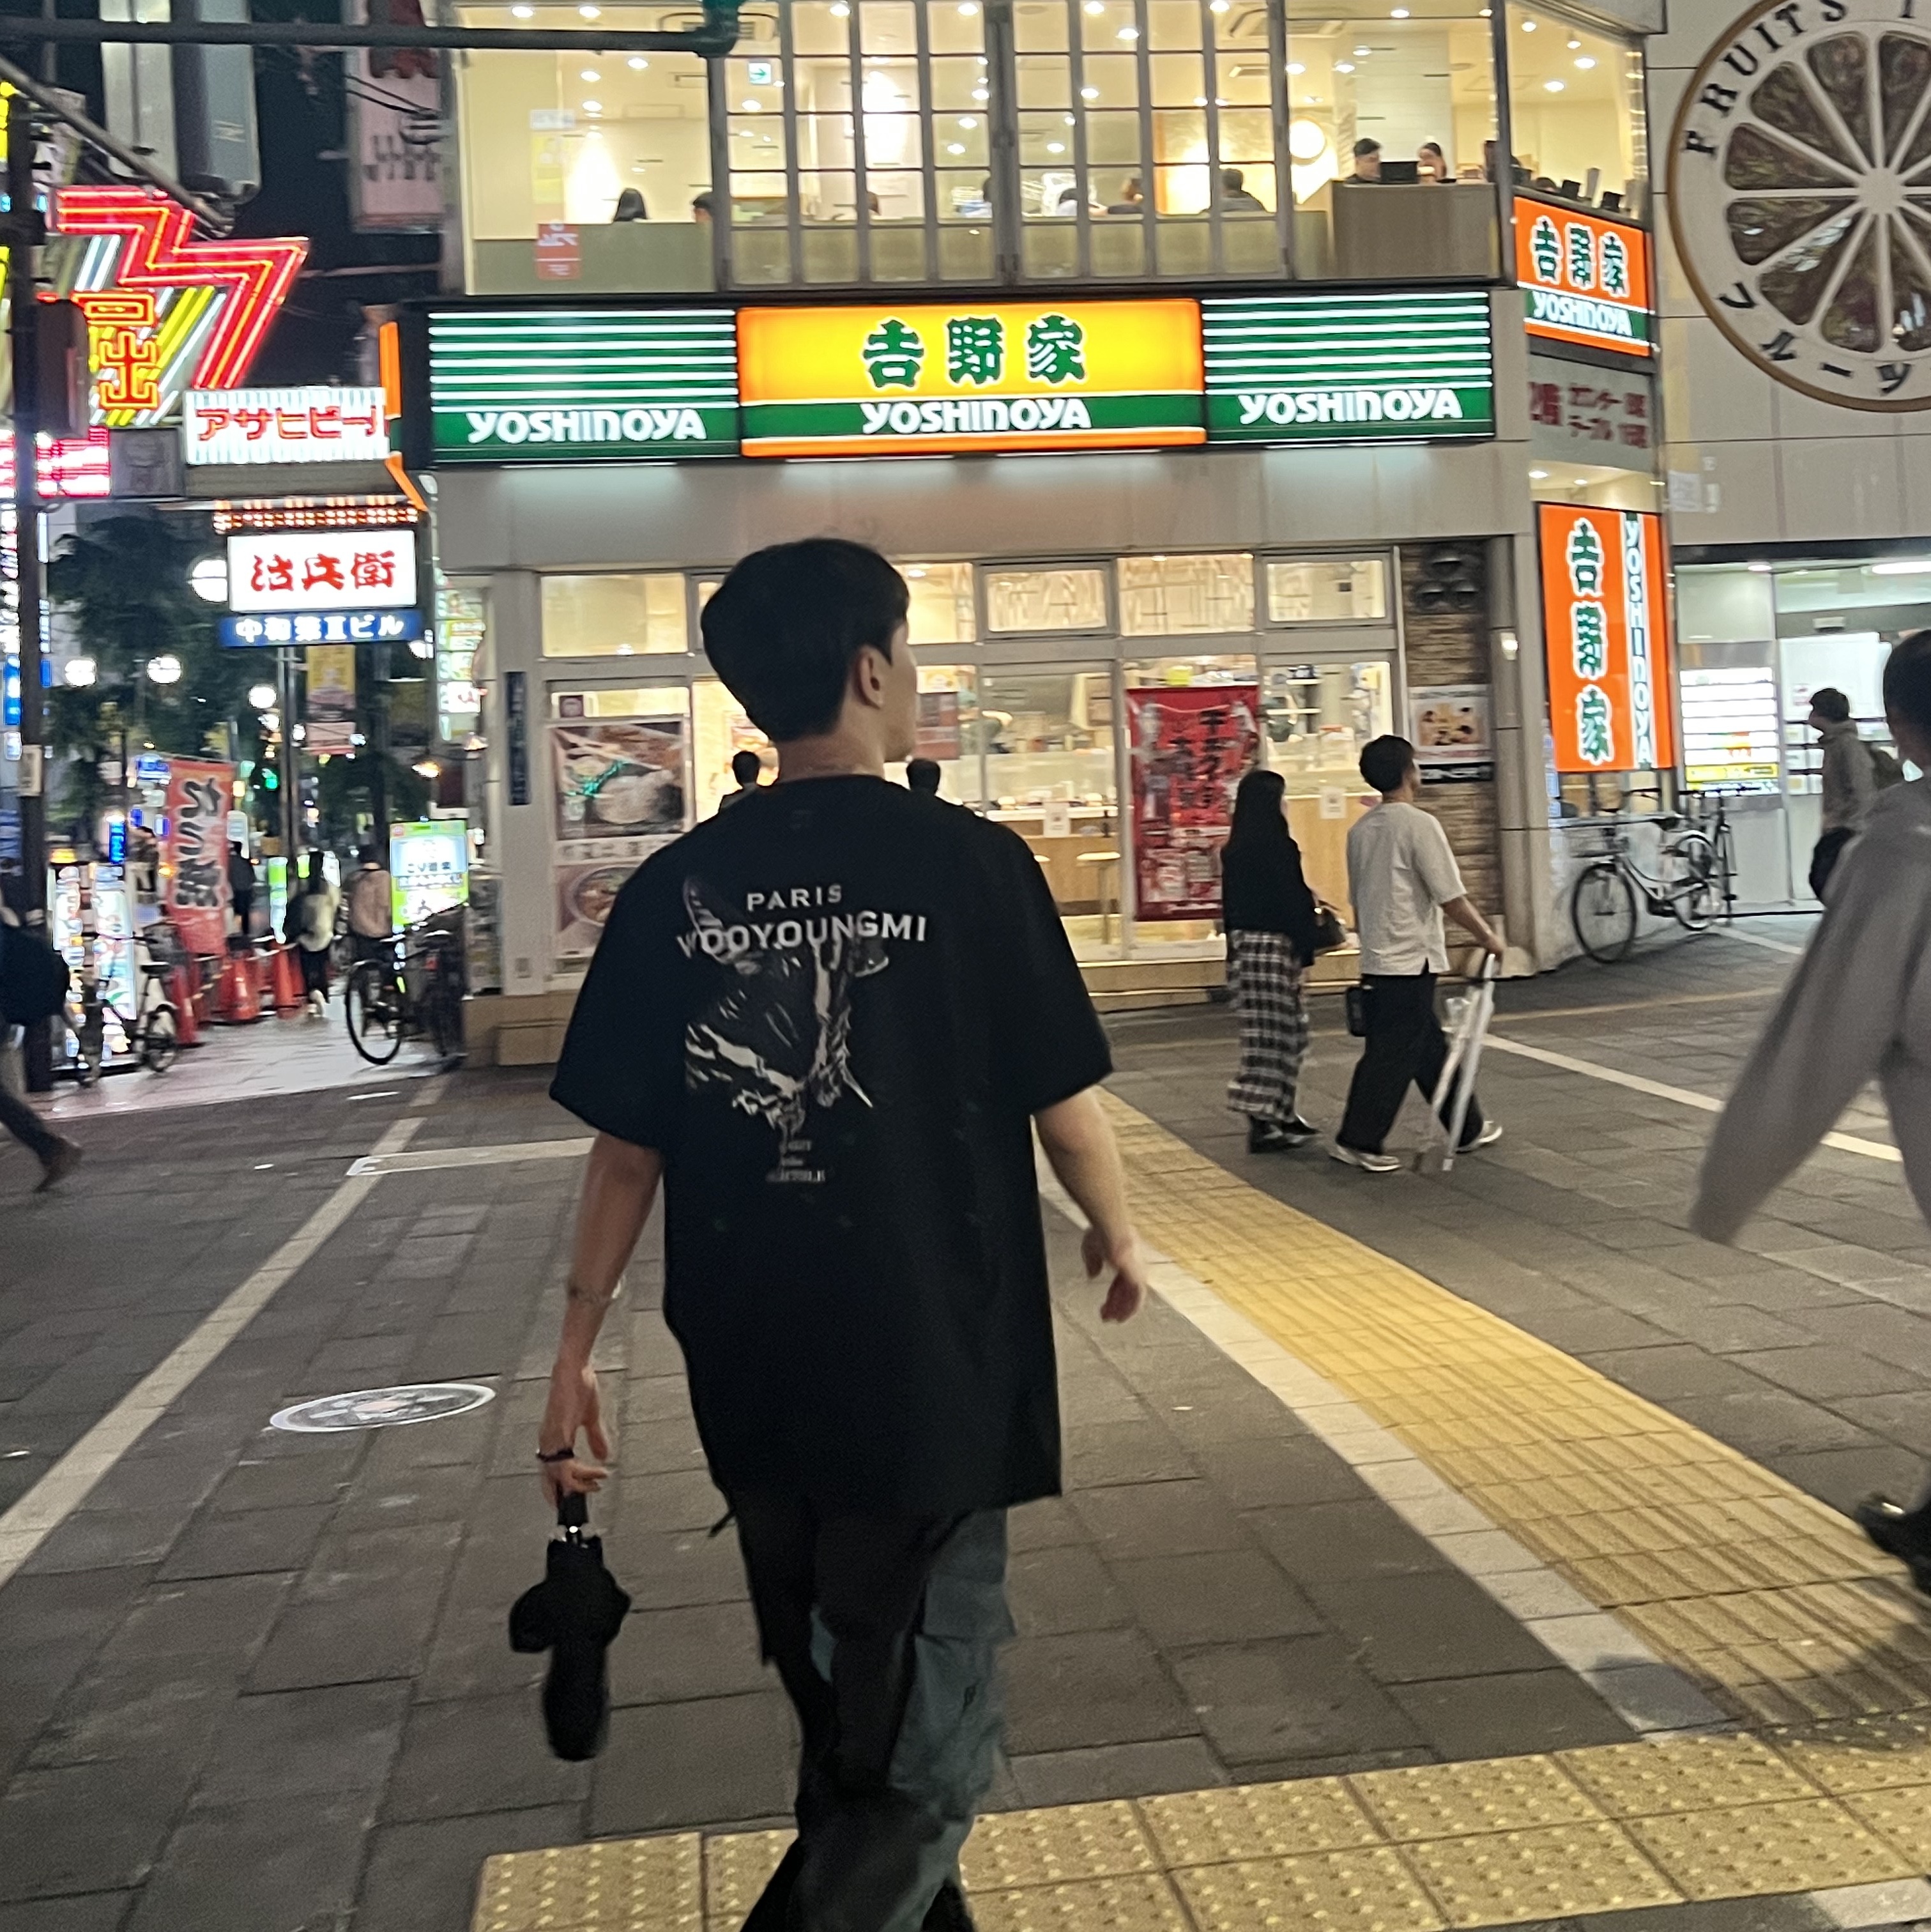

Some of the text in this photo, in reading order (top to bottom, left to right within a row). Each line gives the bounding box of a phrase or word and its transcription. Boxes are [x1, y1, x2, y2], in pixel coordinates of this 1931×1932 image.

[1531, 216, 1629, 297] 吉野家
[1532, 290, 1633, 337] YOSHINOYA
[863, 315, 1087, 389] 吉野家
[465, 409, 707, 444] YOSHINOYA
[860, 398, 1092, 434] YOSHINOYA
[1237, 388, 1463, 425] YOSHINOYA
[1566, 517, 1616, 765] 吉野家
[1624, 520, 1653, 764] YOSHINOYA
[745, 884, 843, 912] PARIS
[675, 910, 927, 958] WOOYOUNGMI
